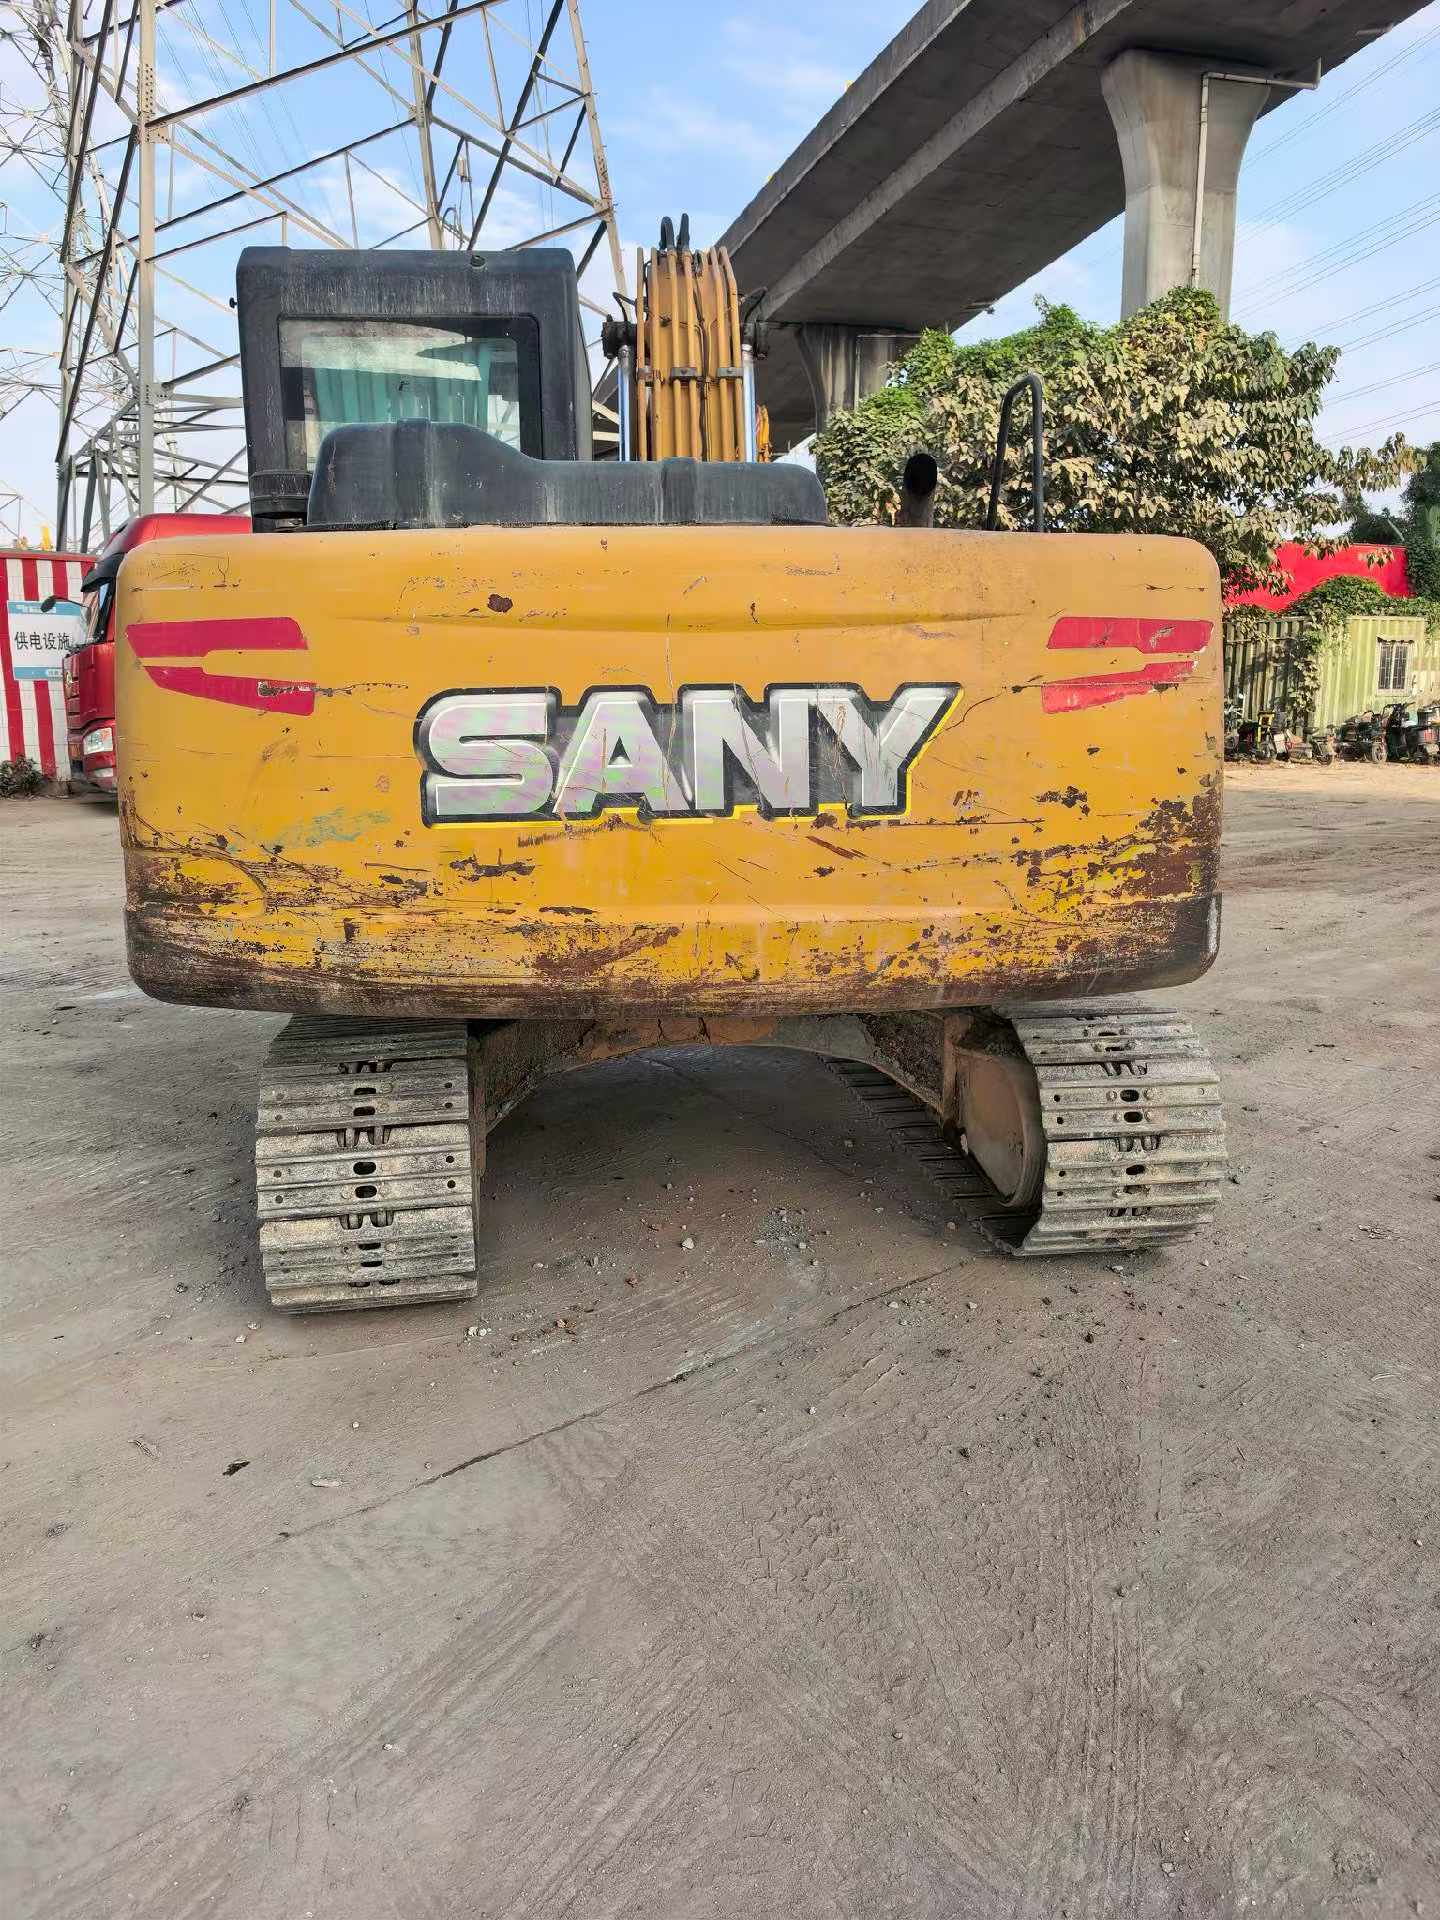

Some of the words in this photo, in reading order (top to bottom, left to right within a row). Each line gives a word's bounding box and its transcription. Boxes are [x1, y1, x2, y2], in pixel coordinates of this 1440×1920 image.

[14, 631, 71, 651] 供电设施
[417, 685, 957, 825] SANY
